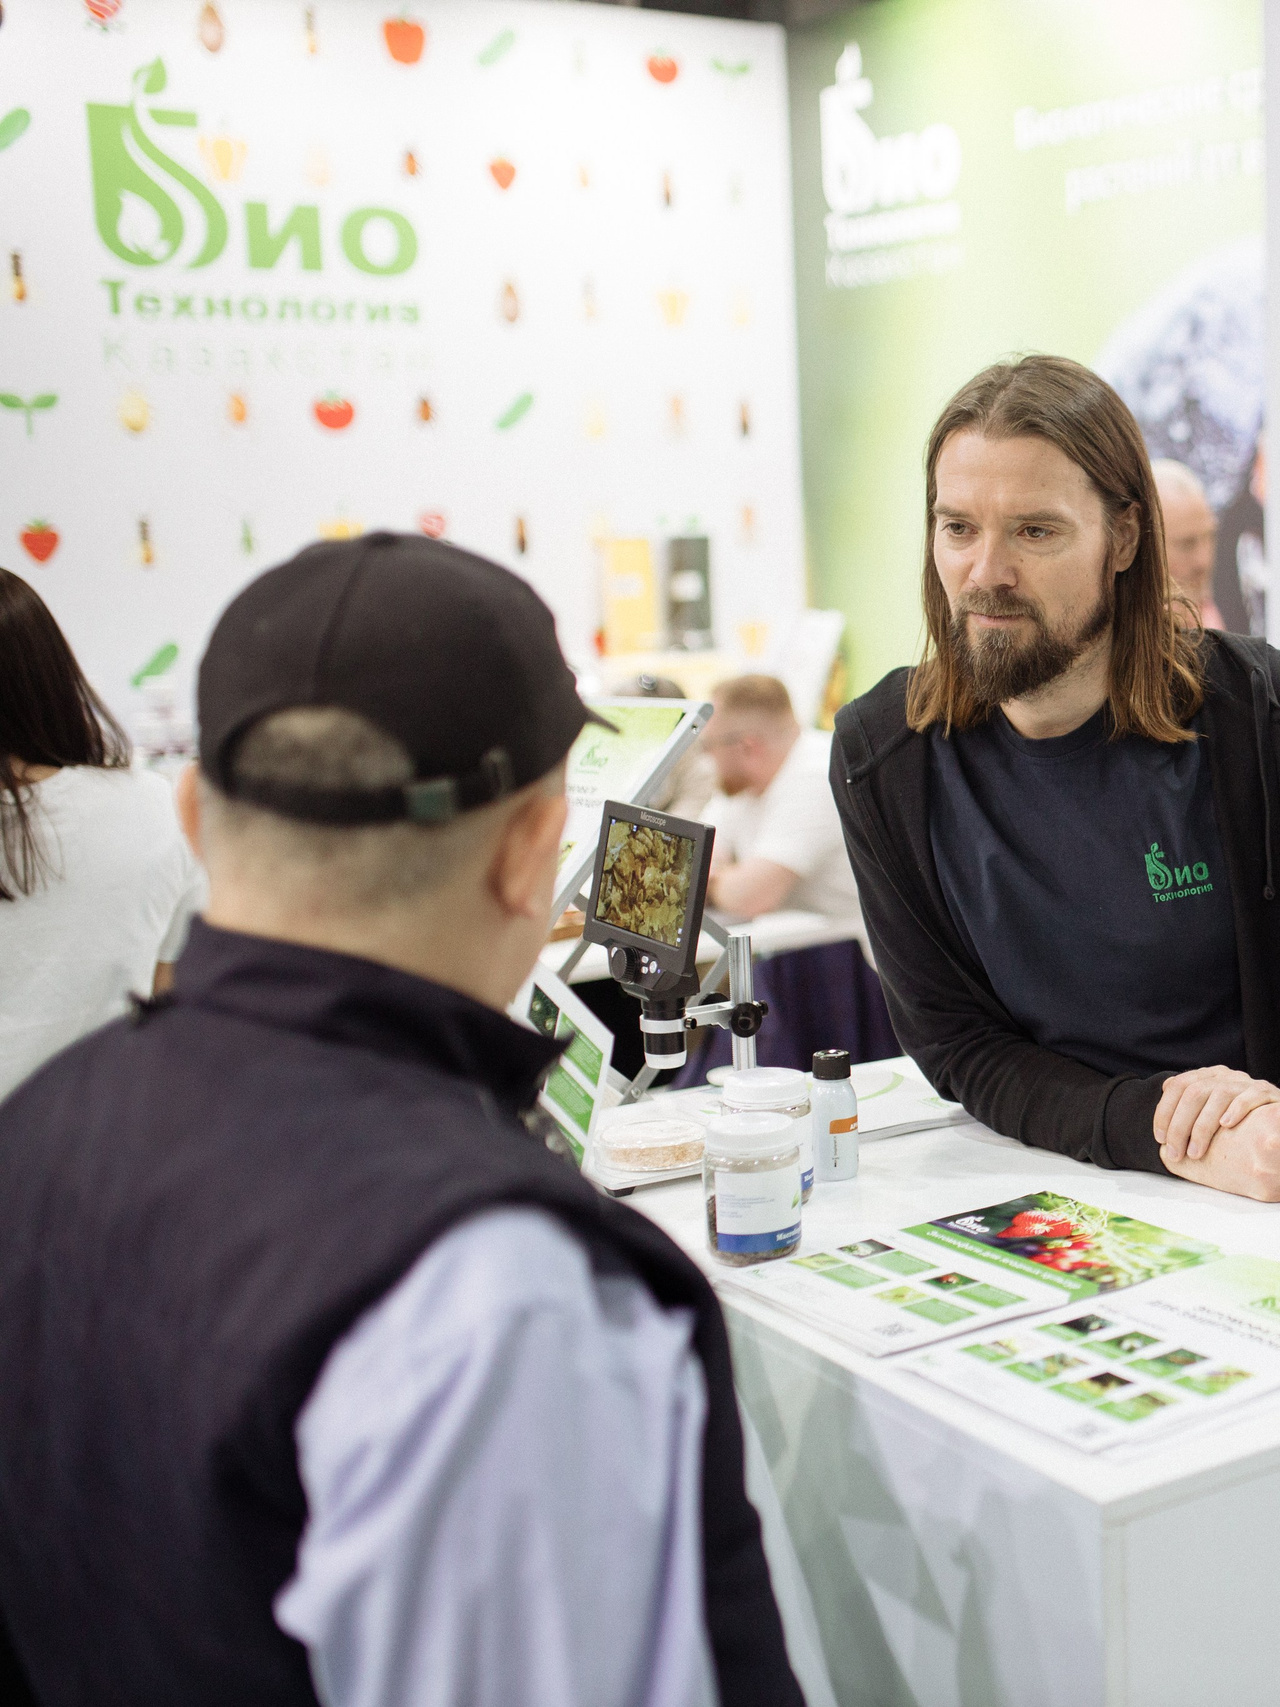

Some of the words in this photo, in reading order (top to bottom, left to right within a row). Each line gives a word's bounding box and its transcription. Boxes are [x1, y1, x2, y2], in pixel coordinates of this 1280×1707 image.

[86, 58, 419, 277] Био
[99, 278, 421, 324] Технология
[640, 811, 667, 827] Microscope
[1144, 842, 1209, 891] Био
[1152, 883, 1214, 903] Технология
